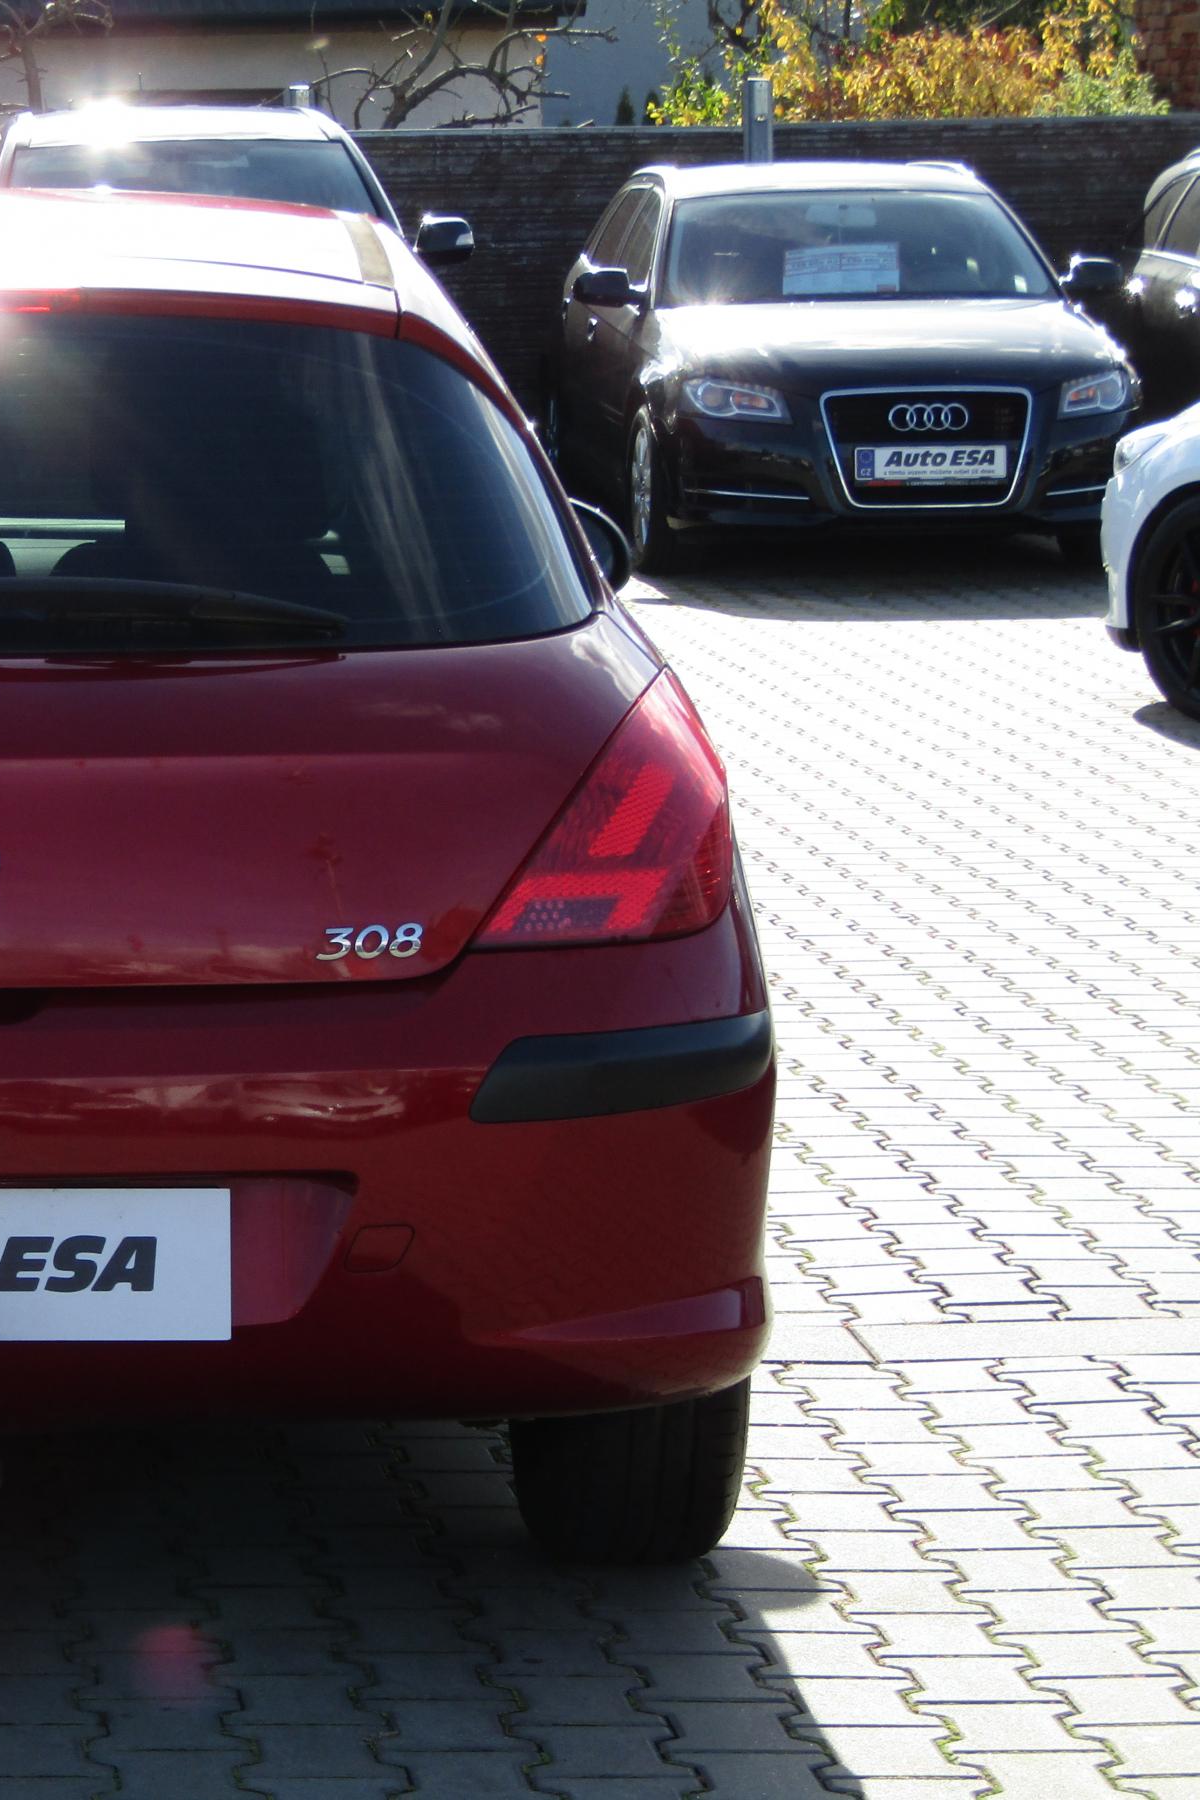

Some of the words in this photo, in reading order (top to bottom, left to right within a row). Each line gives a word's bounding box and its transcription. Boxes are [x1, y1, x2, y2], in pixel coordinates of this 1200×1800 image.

[884, 450, 947, 467] Auto
[949, 449, 995, 466] ESA
[860, 468, 871, 476] CZ
[316, 922, 423, 961] 308
